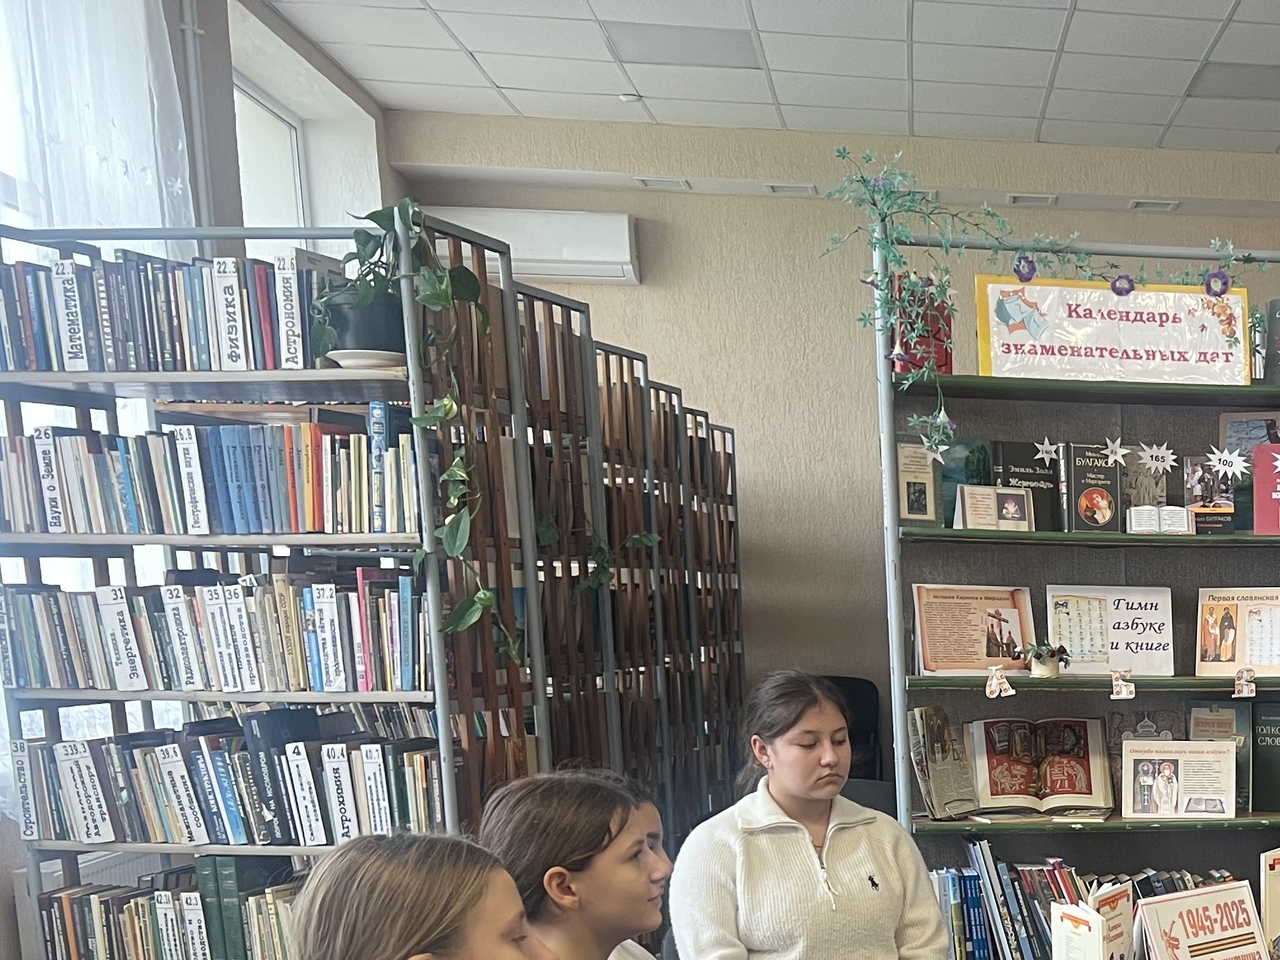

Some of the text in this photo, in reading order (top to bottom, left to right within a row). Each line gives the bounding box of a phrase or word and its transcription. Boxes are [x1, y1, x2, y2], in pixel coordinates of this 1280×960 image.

[55, 262, 76, 277] 22.1
[216, 260, 237, 275] 22.3
[276, 256, 295, 271] 22.6
[61, 278, 84, 360] Математика
[282, 276, 300, 365] Астрономия
[1065, 303, 1183, 325] Календарь
[223, 285, 240, 363] Физика
[1001, 340, 1235, 365] знаменательных дат
[34, 427, 52, 440] 26
[174, 427, 195, 441] 26.8
[40, 449, 54, 479] Земле
[1149, 454, 1166, 462] 165
[1218, 458, 1234, 468] 100
[1008, 465, 1053, 474] Эмиль Зола
[182, 447, 200, 529] Географические науки
[1009, 478, 1054, 488] Жерминаль
[48, 497, 62, 527] Науки
[111, 588, 125, 601] 31
[166, 588, 182, 599] 32
[207, 589, 220, 600] 35
[226, 589, 239, 599] 36
[316, 588, 335, 599] 37.2
[1207, 593, 1235, 603] Первая
[1238, 593, 1278, 603] славянская
[1112, 597, 1160, 613] Гимн
[1112, 618, 1166, 633] азбуке
[115, 610, 139, 679] Энергетика
[171, 606, 195, 685] Радиоэлектроника
[236, 607, 256, 685] производства
[1109, 638, 1170, 654] и книге
[13, 742, 25, 754] 38
[160, 749, 179, 760] 39.6
[292, 745, 301, 756] 4
[326, 748, 346, 761] 40.4
[365, 748, 380, 760] 40.7
[258, 751, 273, 796] КОСМОДРОМ
[294, 763, 304, 792] лесное
[16, 760, 35, 837] Строительство
[73, 760, 101, 837] Автодорожный
[85, 764, 107, 822] транспорт
[180, 774, 202, 828] сообщения
[167, 771, 195, 842] Межпланетные
[268, 799, 275, 809] НА
[306, 781, 319, 822] хозяйство
[331, 766, 351, 838] Агрохимия
[302, 805, 315, 841] Сельское
[184, 895, 200, 906] 42.3
[1178, 899, 1251, 940] 1945-2025
